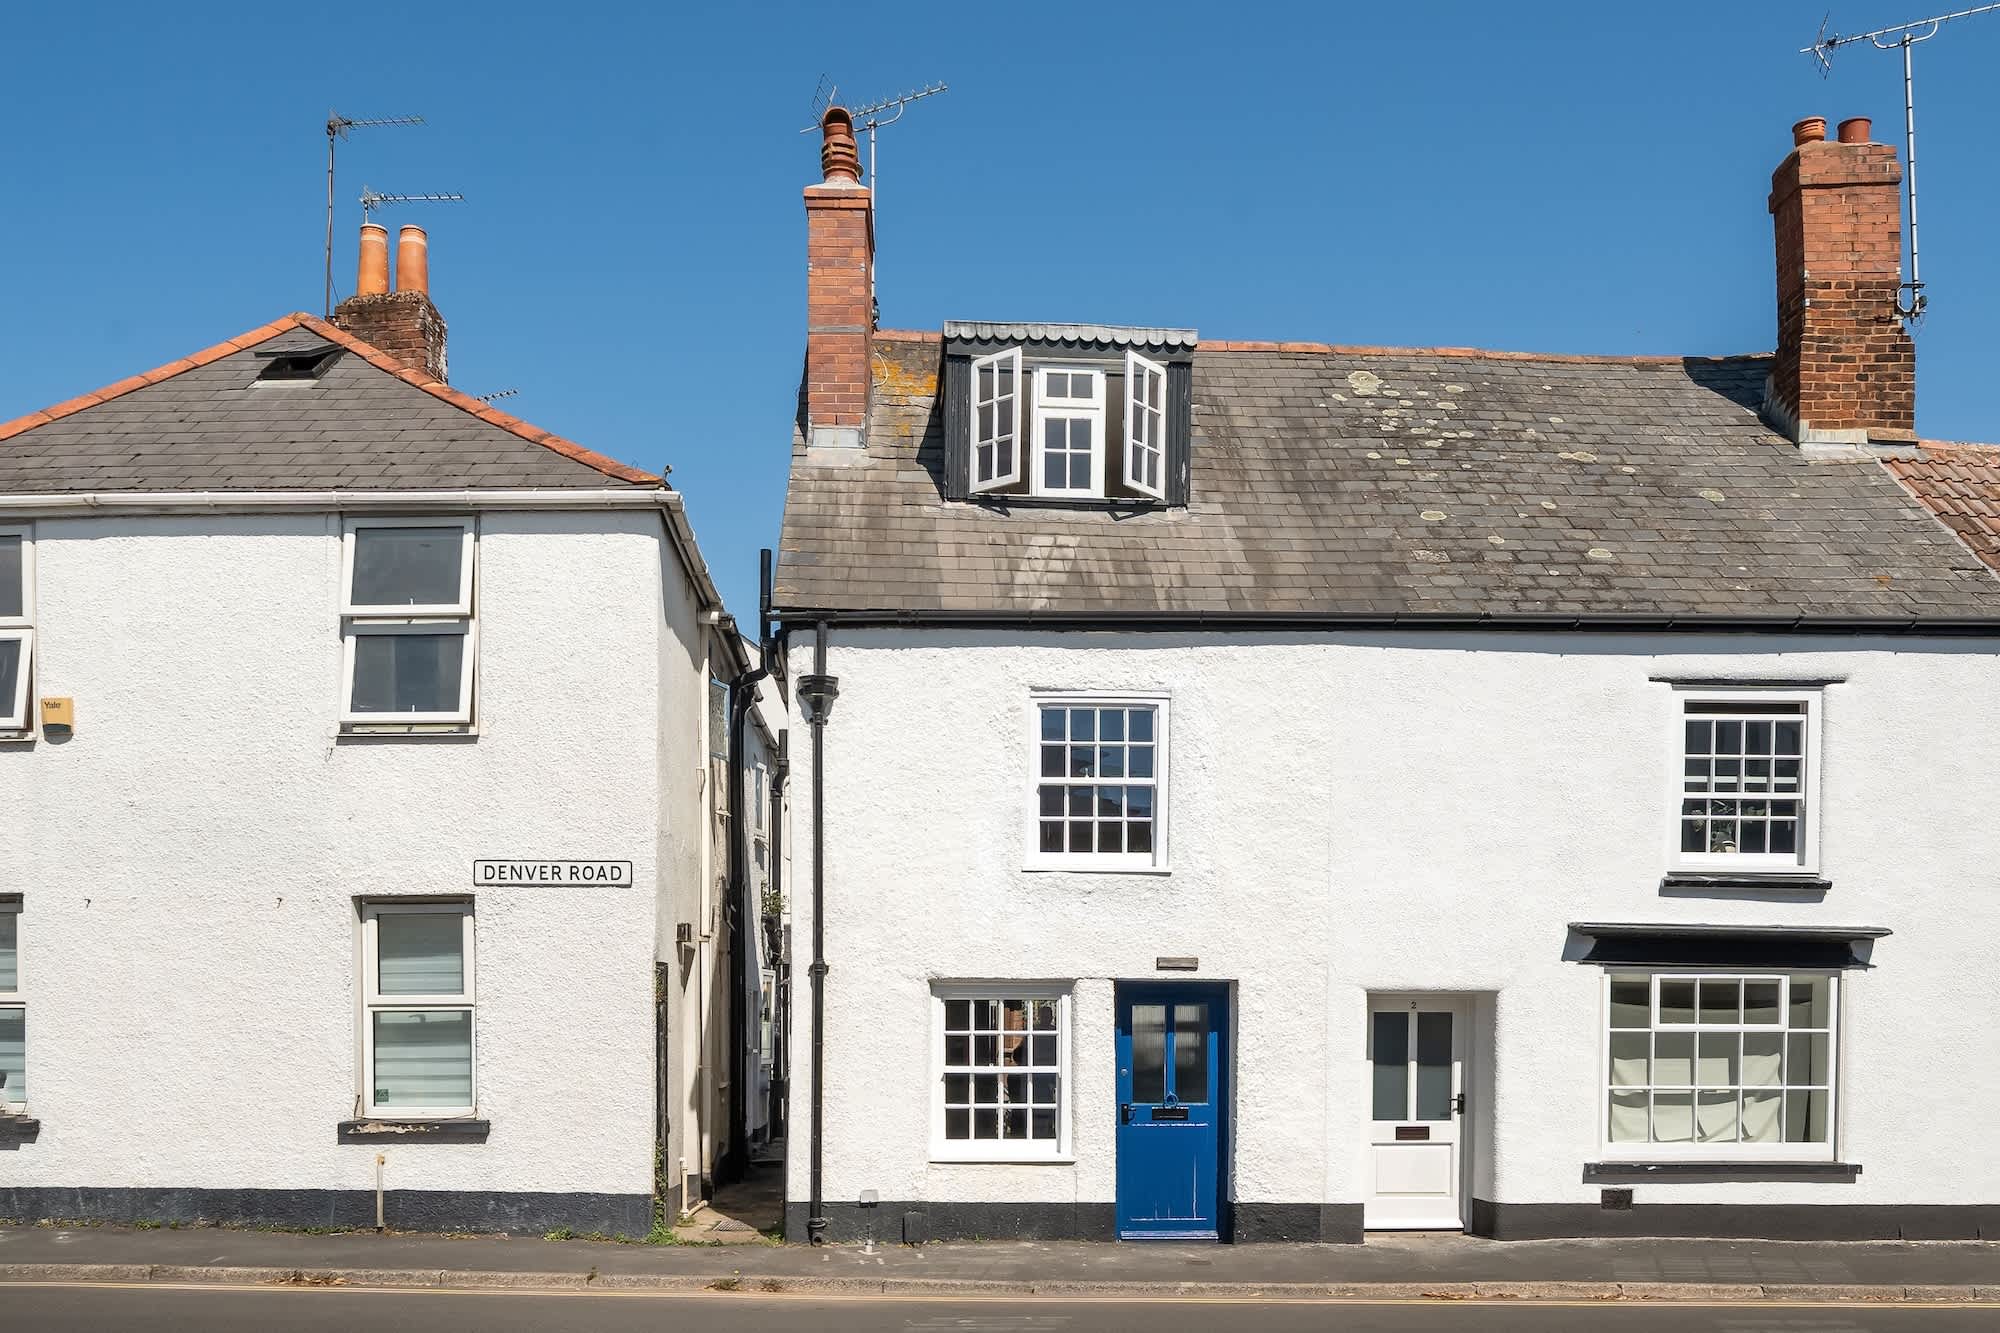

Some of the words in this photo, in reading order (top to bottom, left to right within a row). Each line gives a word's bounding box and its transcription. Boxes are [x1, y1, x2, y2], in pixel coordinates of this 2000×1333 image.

[44, 701, 61, 709] Yale
[484, 865, 562, 881] DENVER
[570, 865, 622, 881] ROAD
[1411, 1001, 1417, 1009] 2
